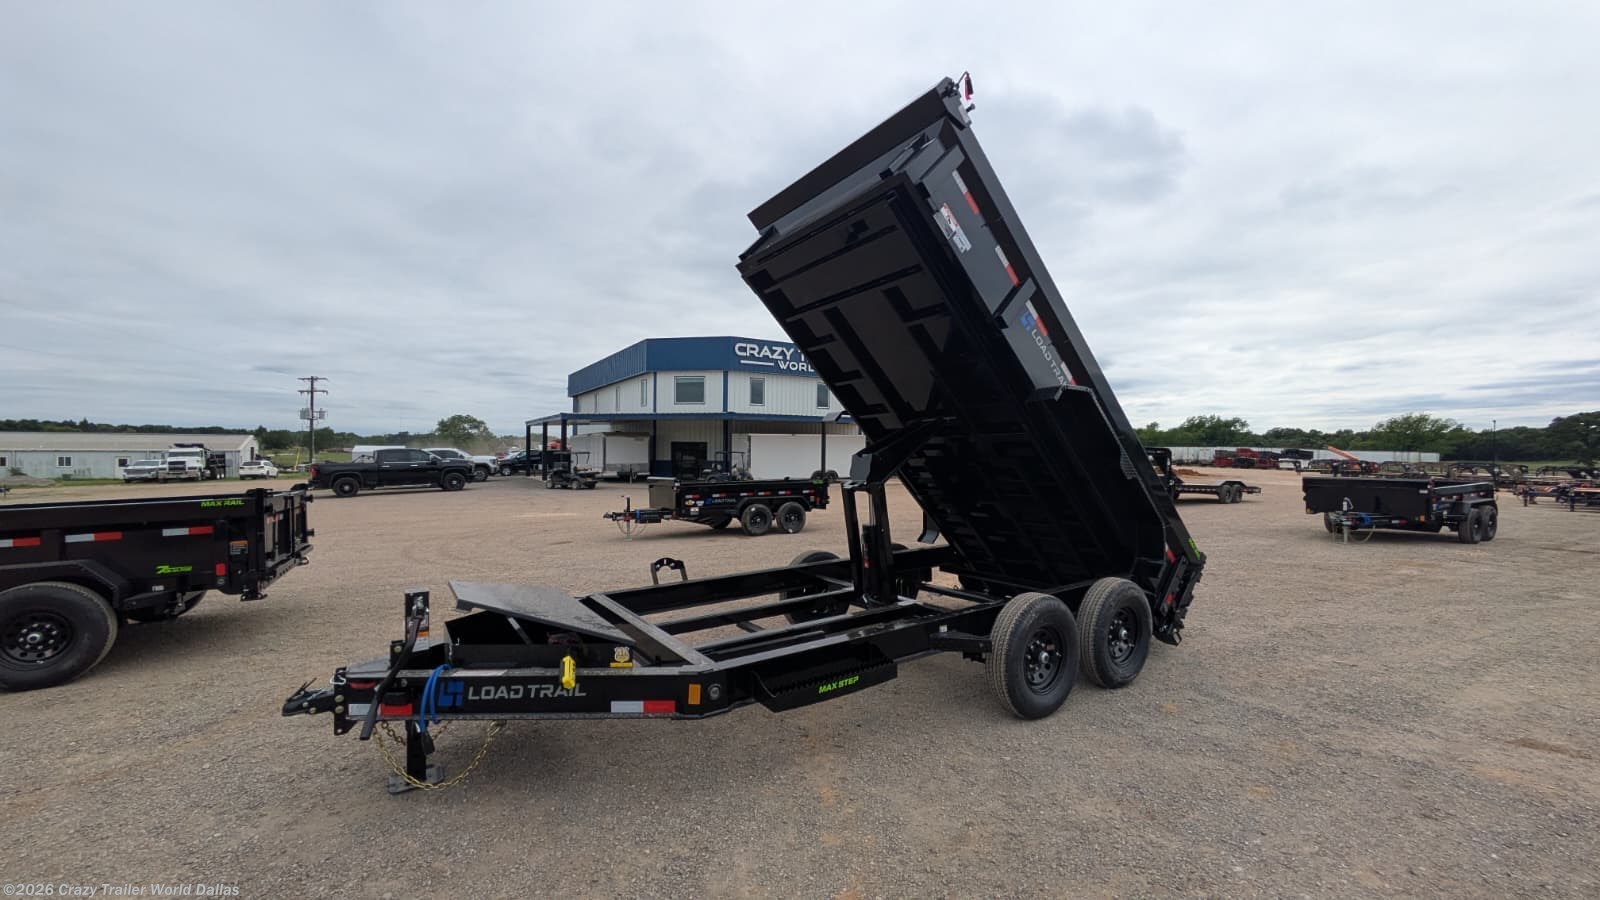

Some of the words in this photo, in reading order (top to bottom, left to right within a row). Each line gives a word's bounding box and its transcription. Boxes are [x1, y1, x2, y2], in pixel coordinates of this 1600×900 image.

[734, 343, 795, 360] CRAZY
[777, 359, 816, 373] WORL
[200, 499, 222, 507] MAX
[467, 685, 524, 700] LOAD
[818, 682, 838, 694] MAX
[838, 676, 859, 688] STEP
